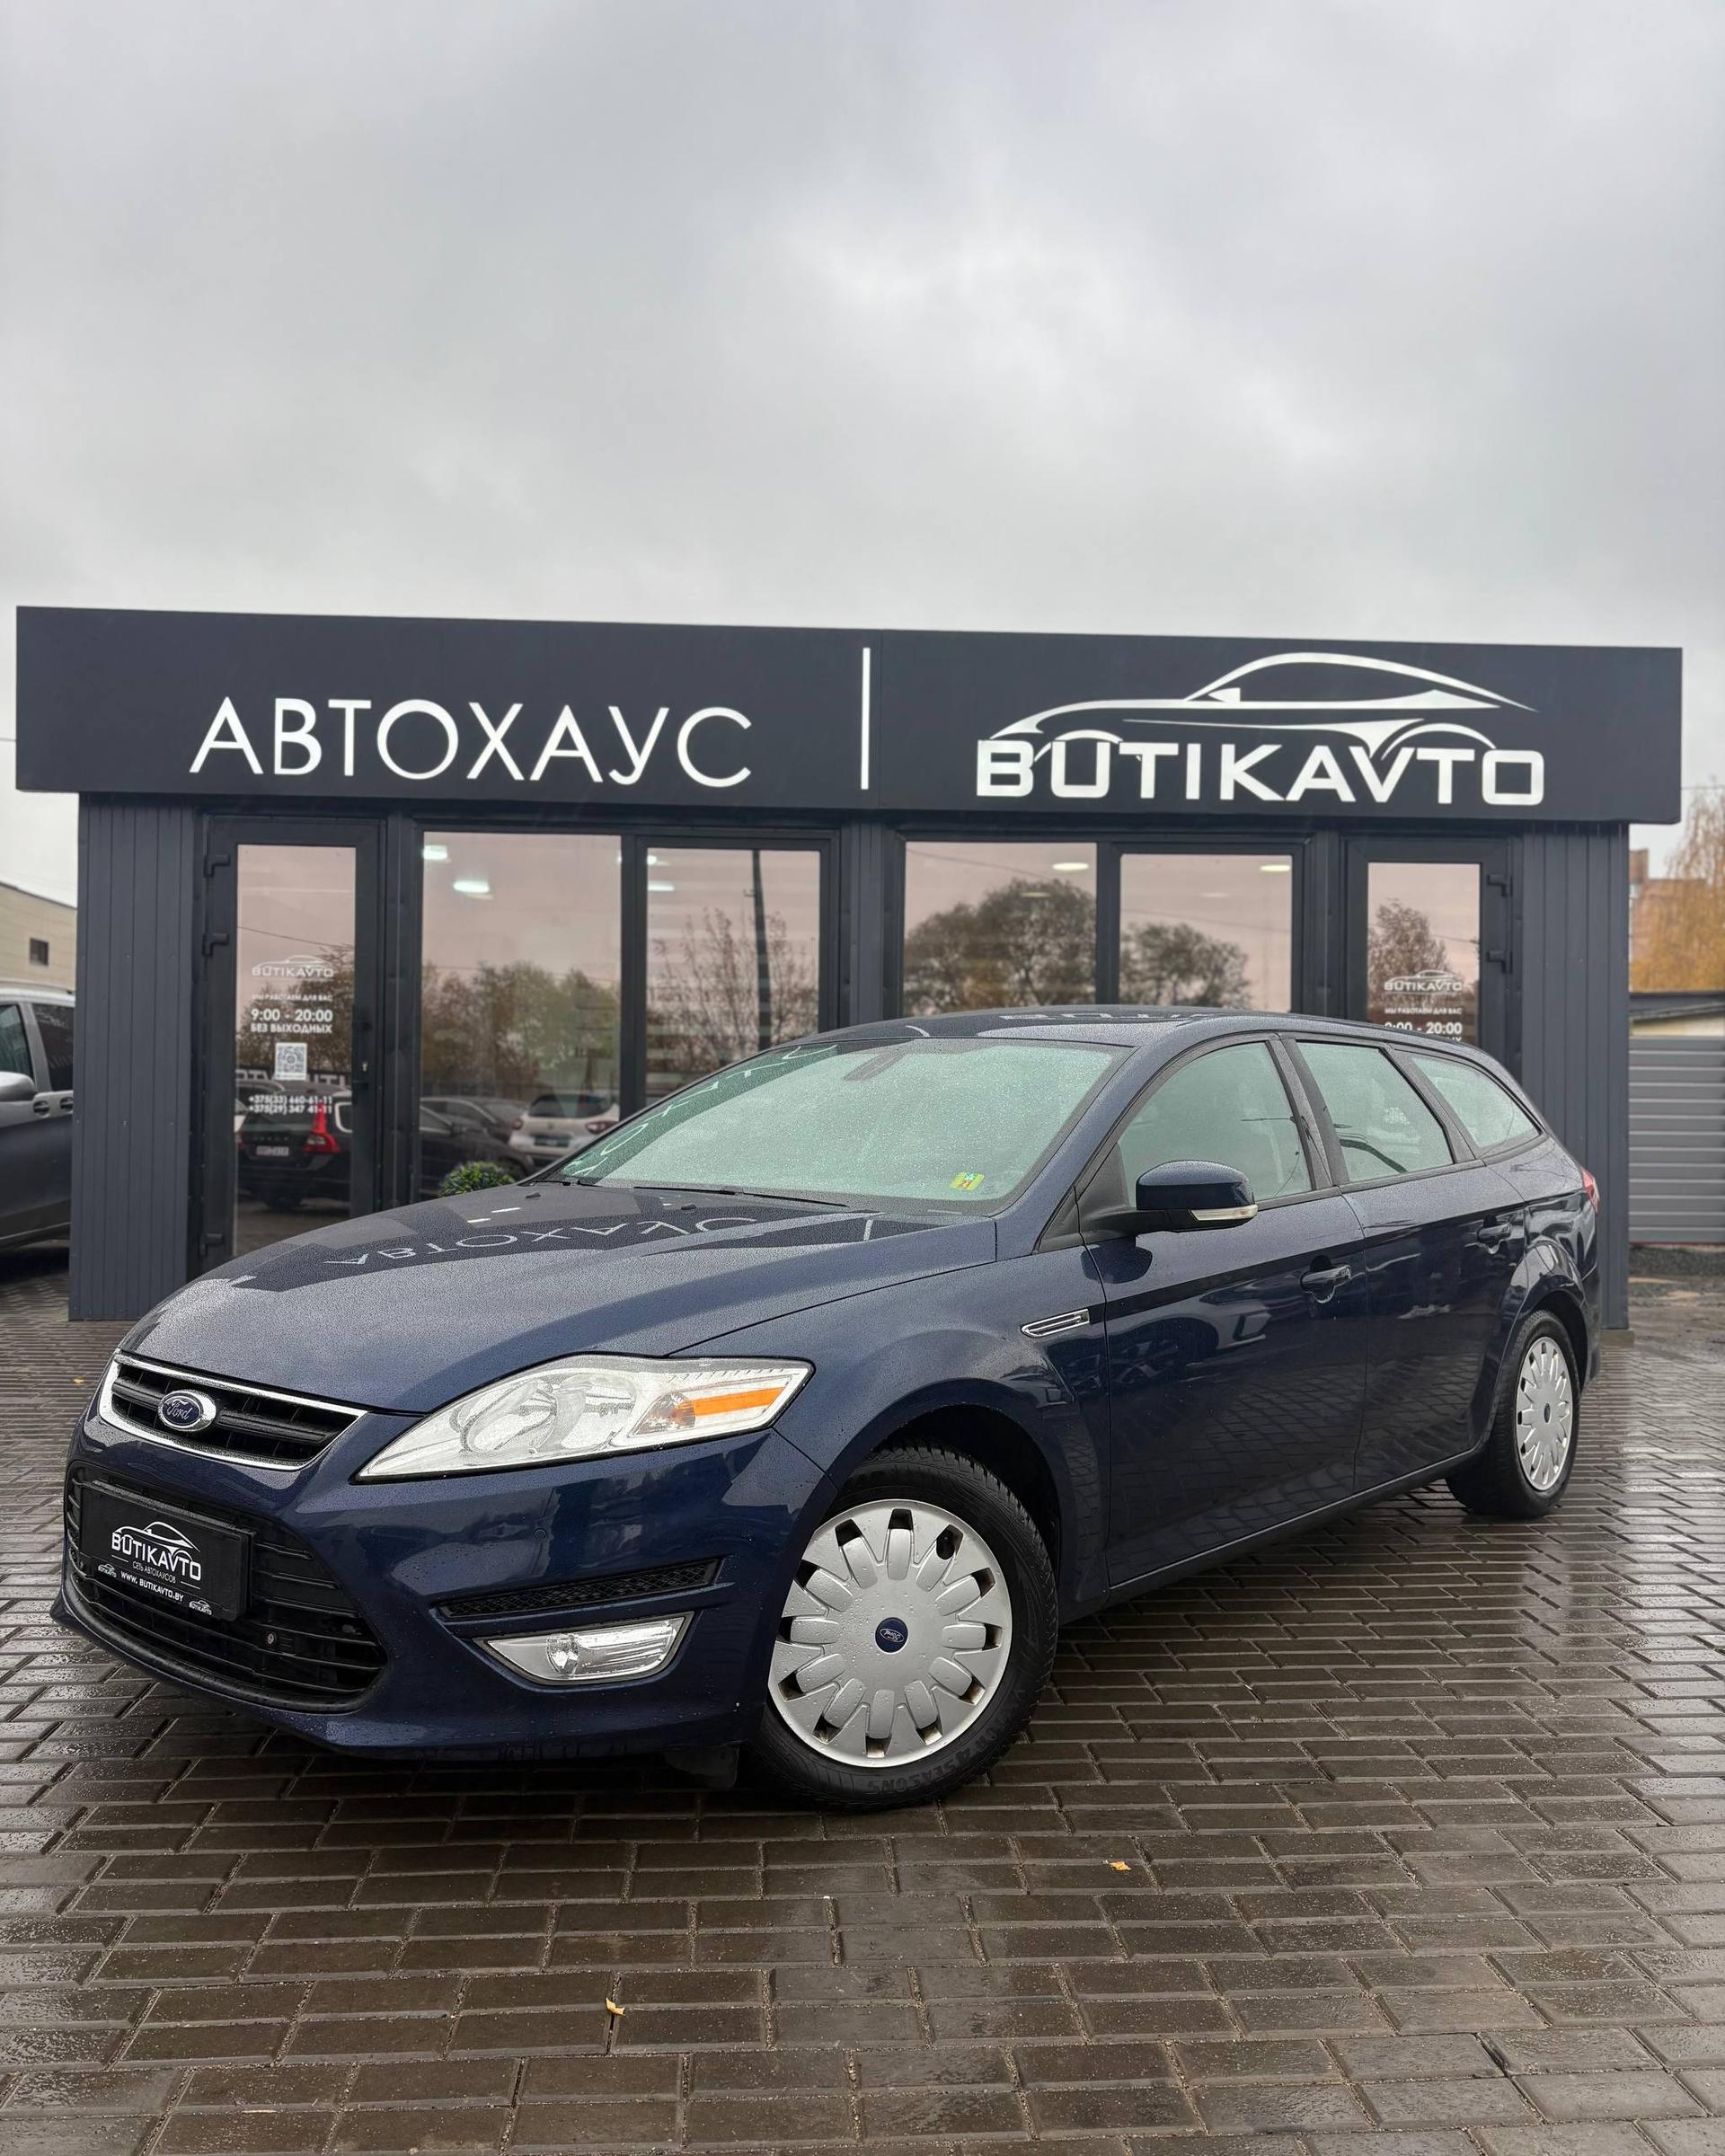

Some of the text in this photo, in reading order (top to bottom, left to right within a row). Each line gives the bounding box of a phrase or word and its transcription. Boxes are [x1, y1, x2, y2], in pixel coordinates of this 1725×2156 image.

[189, 695, 752, 788] АВТОХАУС
[977, 739, 1544, 806] BUTIKAVTO
[252, 966, 334, 977] BUTIKAVTO
[1384, 981, 1463, 991] BUTIKAVTO
[252, 1009, 280, 1021] 9:00
[295, 1009, 333, 1021] 20:00
[251, 1023, 332, 1033] БЕЗ ВЫХОДНЫХ
[1426, 1021, 1463, 1035] 20:00
[249, 1094, 288, 1106] +375(33)
[249, 1105, 288, 1115] +375(29)
[111, 1532, 201, 1581] BUTIKAVTO
[144, 1567, 177, 1584] АВТОХАУСОВ
[139, 1577, 184, 1603] BUTIKAVTO.BY
